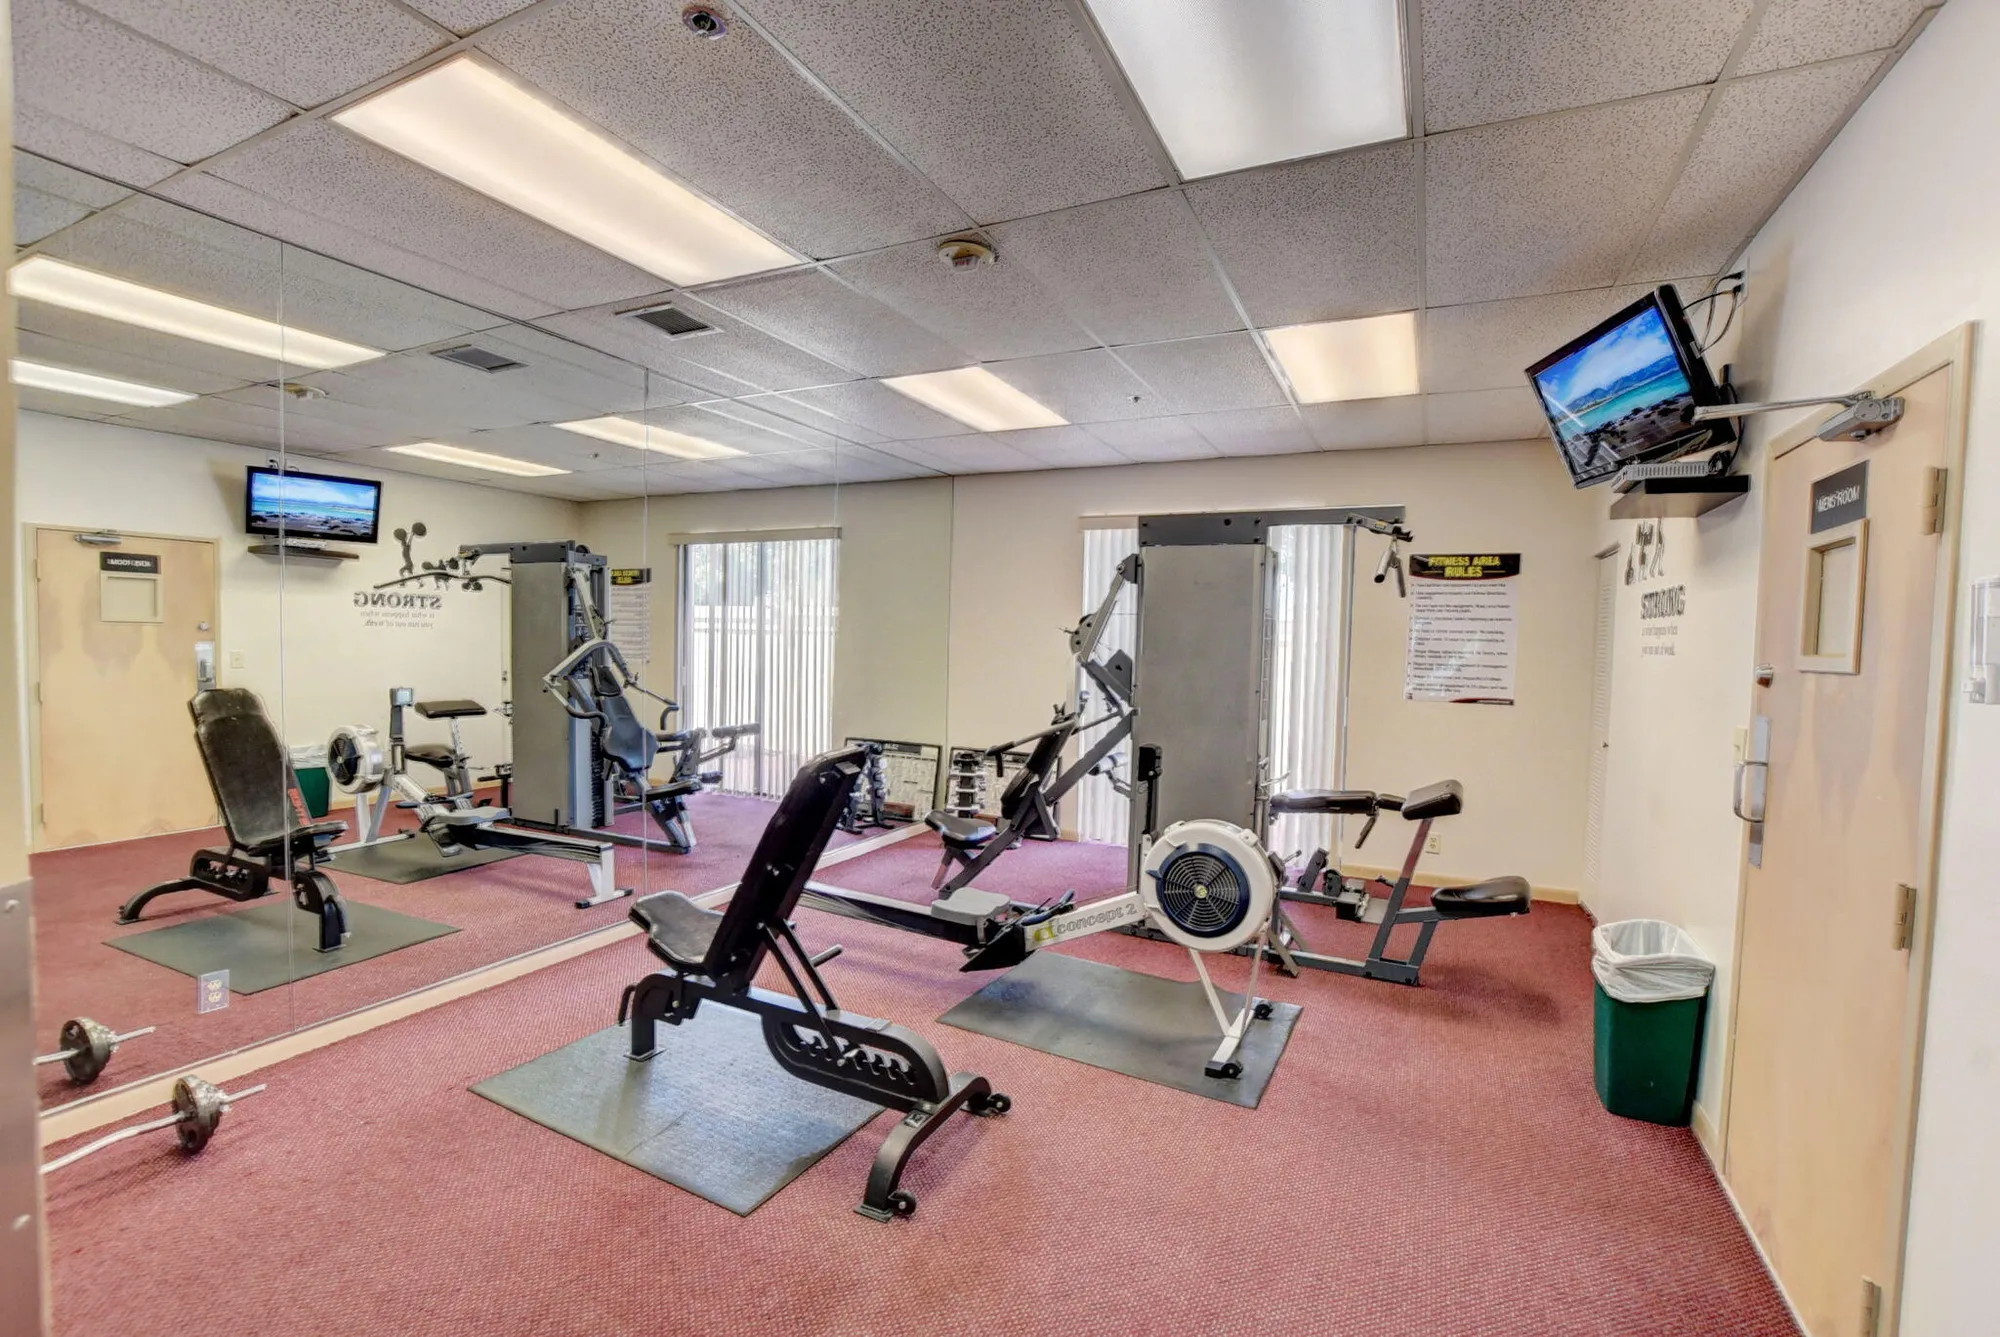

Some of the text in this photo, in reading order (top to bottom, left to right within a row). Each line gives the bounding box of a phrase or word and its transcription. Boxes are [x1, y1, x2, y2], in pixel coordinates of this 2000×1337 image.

[1836, 486, 1860, 506] ROOM
[1428, 556, 1501, 567] FITNESS AREA
[1444, 566, 1482, 578] RULES
[1640, 584, 1686, 620] STRONG
[1057, 903, 1138, 934] concept 2
